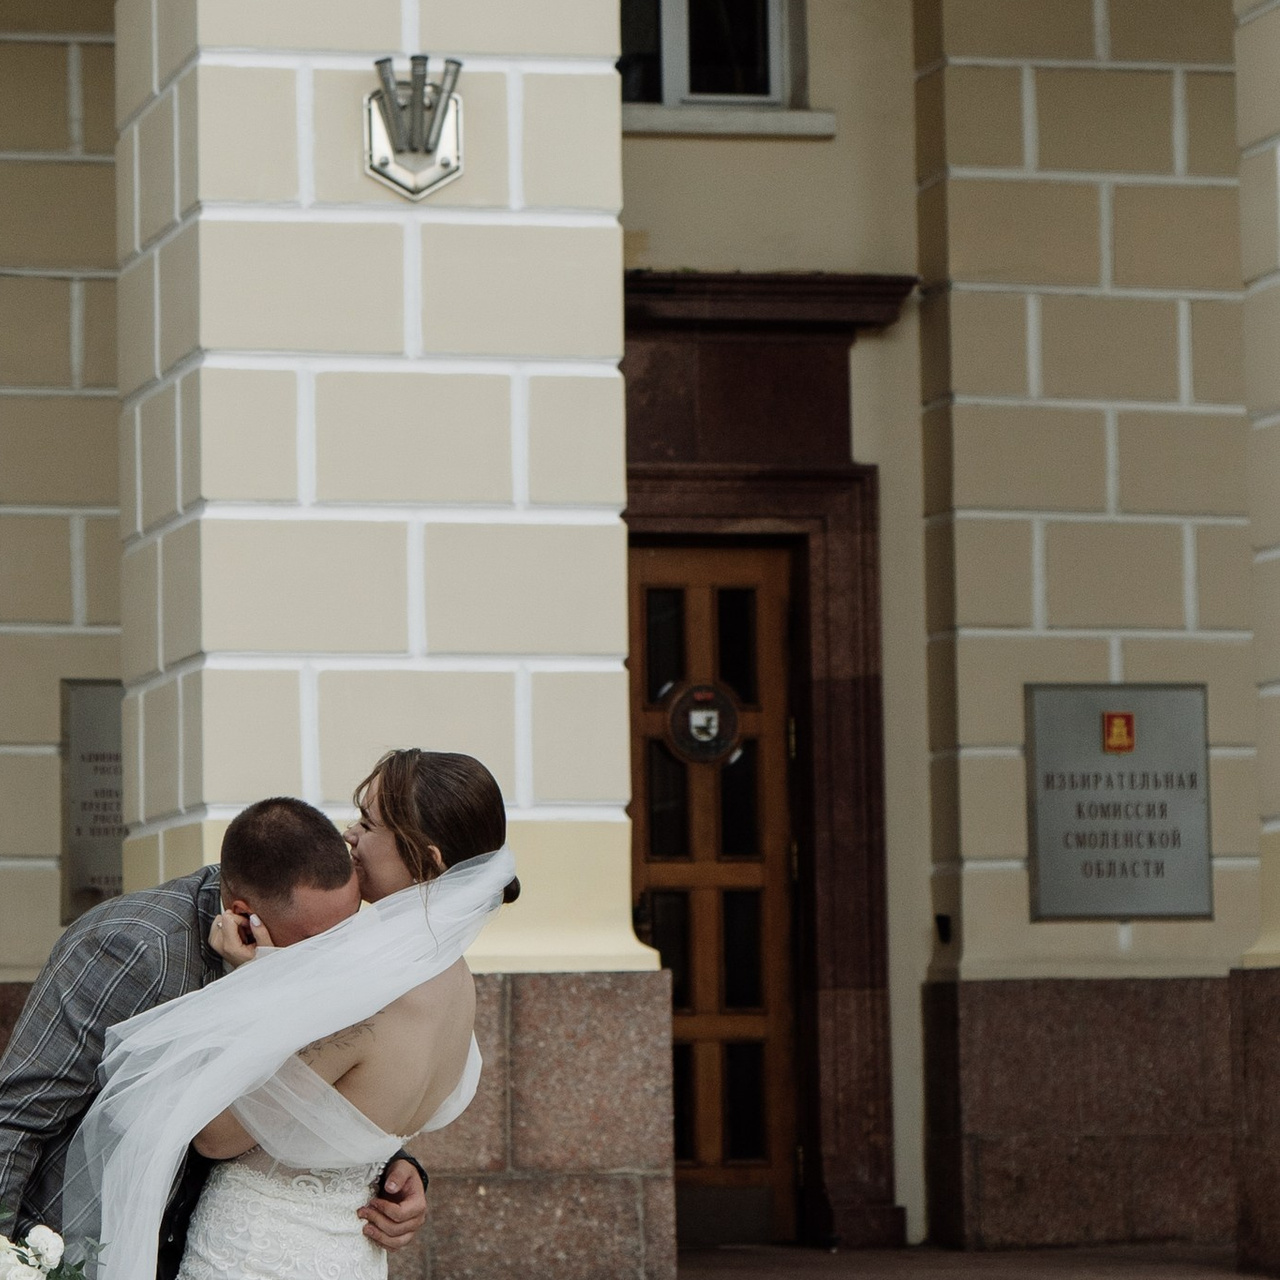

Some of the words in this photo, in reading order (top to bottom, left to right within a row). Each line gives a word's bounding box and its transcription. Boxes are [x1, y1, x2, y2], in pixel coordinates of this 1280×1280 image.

[1043, 771, 1199, 791] ИЗБИРАТЕЛЬНАЯ
[1076, 800, 1168, 820] КОМИССИЯ
[1062, 828, 1182, 850] СМОЛЕНСКОЙ
[1081, 859, 1166, 879] ОБЛАСТИ
